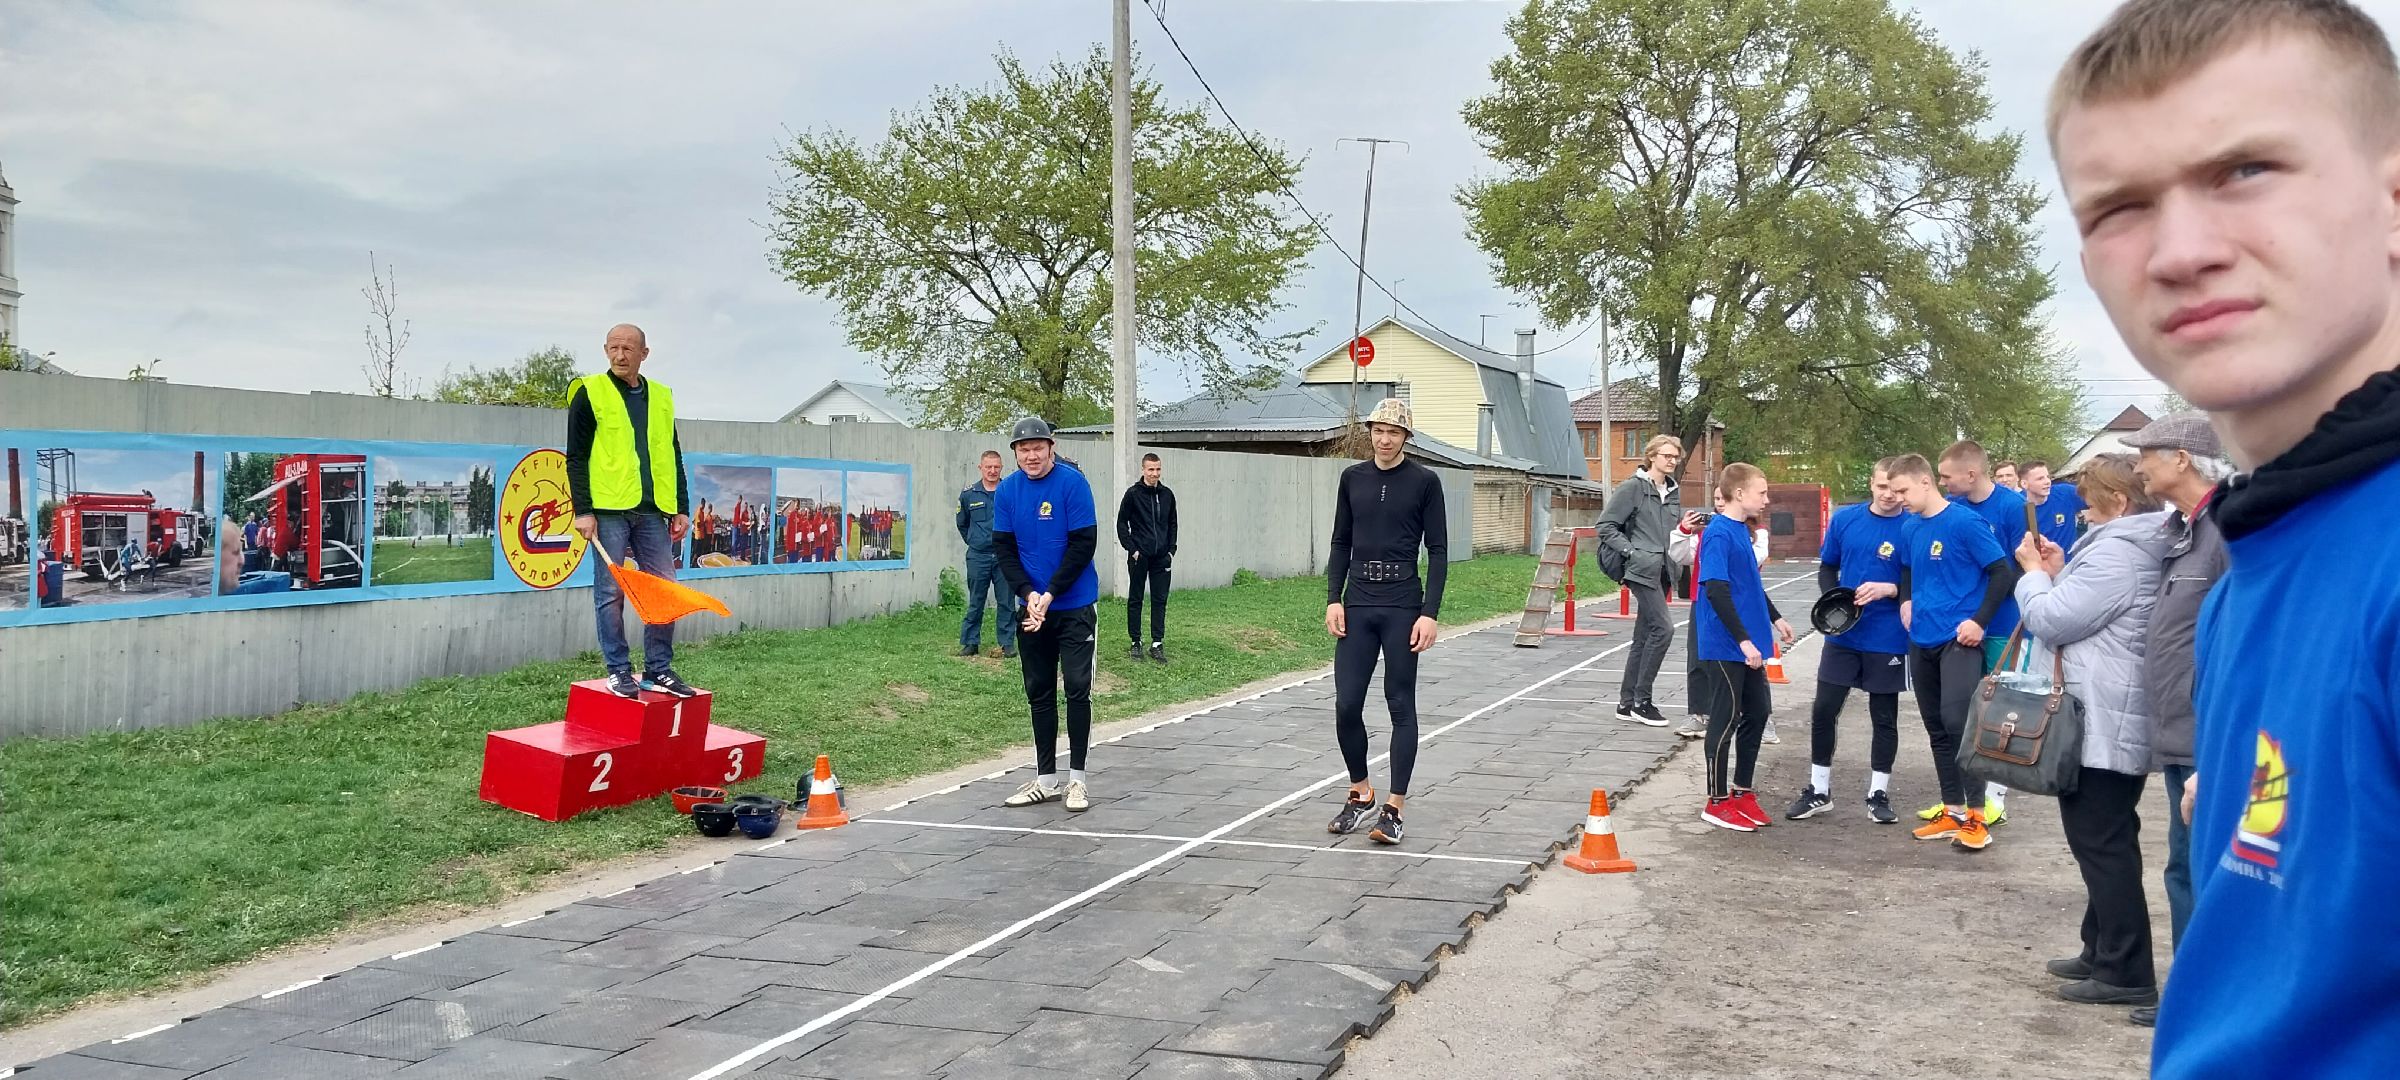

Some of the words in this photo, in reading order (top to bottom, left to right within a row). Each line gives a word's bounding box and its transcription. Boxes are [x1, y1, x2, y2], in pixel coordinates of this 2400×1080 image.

[511, 548, 580, 582] КОЛОМНА
[668, 701, 682, 737] 1
[588, 752, 613, 793] 2
[724, 747, 743, 783] 3
